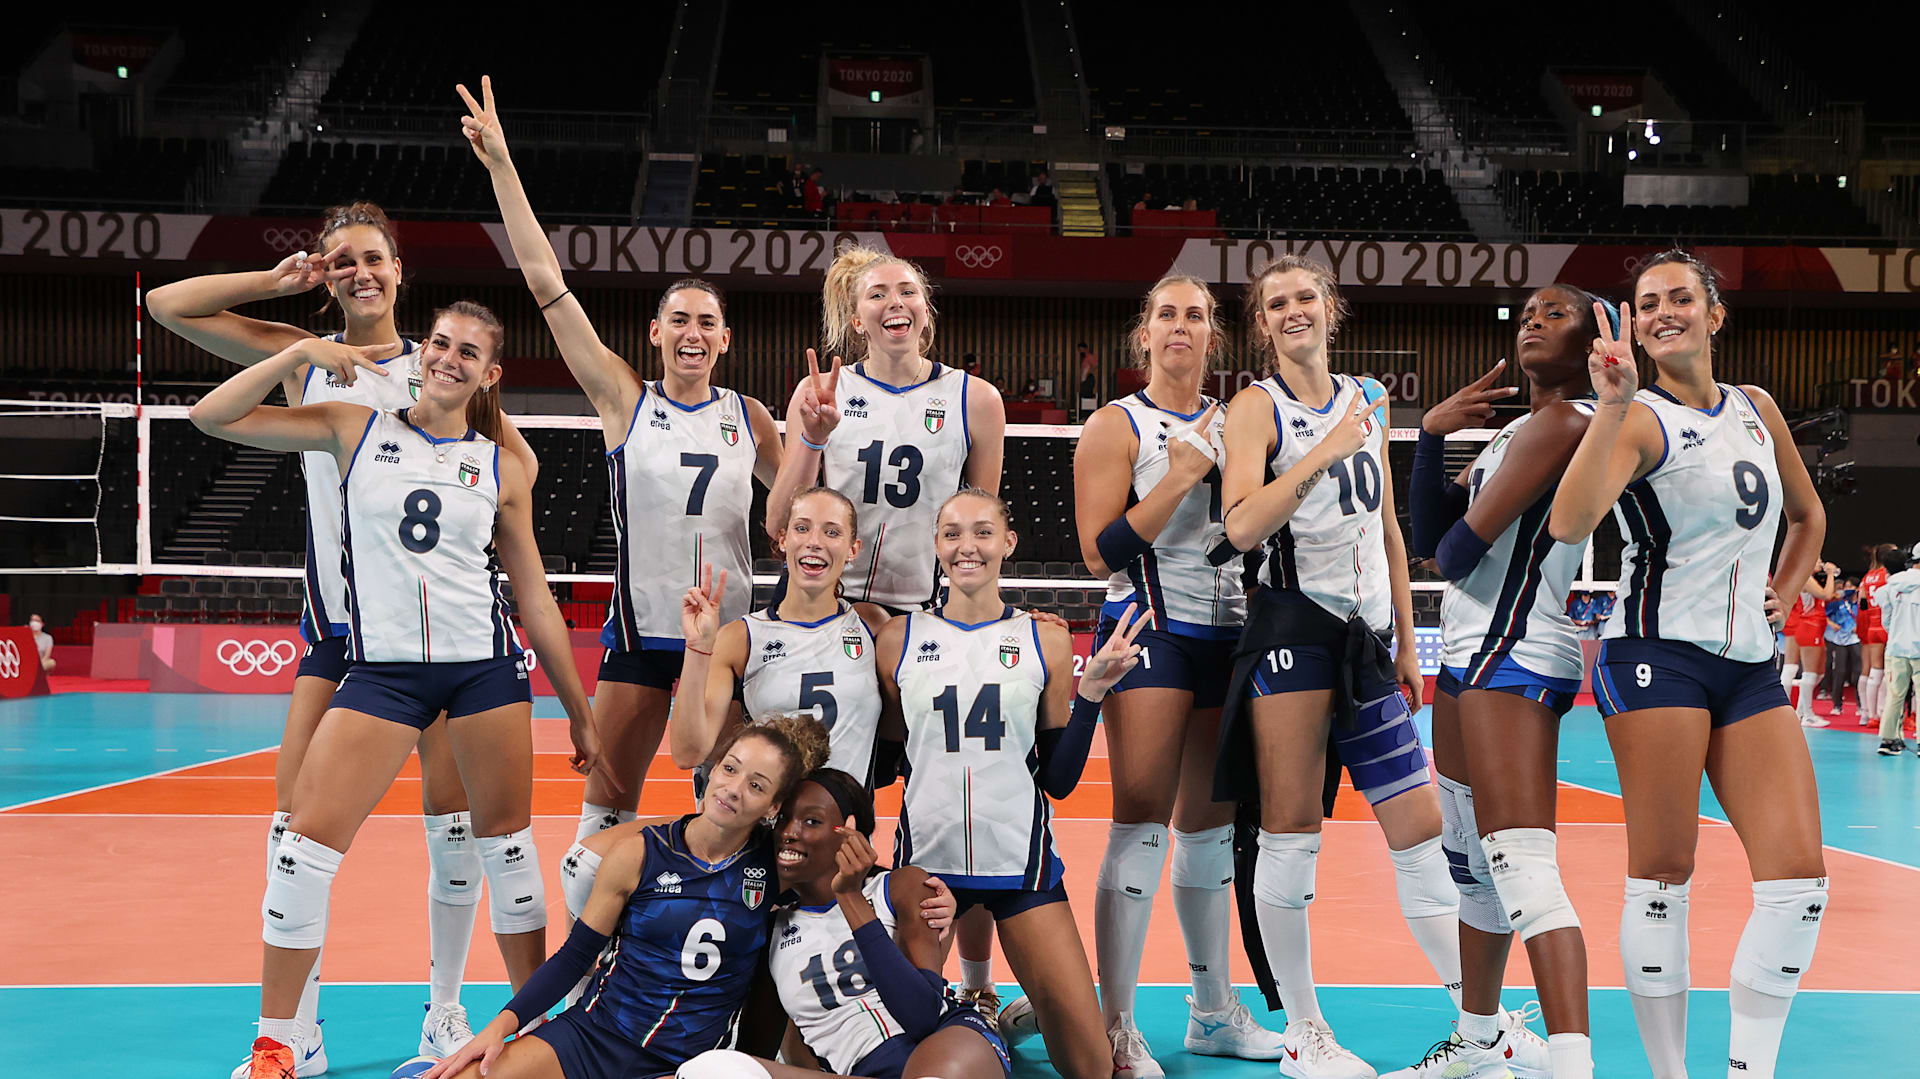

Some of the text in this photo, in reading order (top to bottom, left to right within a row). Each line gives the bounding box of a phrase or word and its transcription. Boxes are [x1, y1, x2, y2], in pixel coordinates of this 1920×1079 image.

[841, 69, 913, 82] TOKYO 2020
[1566, 84, 1633, 97] OKYO 2020
[22, 209, 161, 260] 2020
[1401, 242, 1529, 289] 2020
[1850, 379, 1918, 408] TOK
[844, 410, 868, 419] errea
[1390, 430, 1415, 438] OKYO
[374, 454, 400, 464] errea
[680, 453, 718, 515] 7
[857, 440, 923, 508] 13
[1328, 452, 1380, 516] 10
[1734, 461, 1769, 529] 9
[398, 489, 443, 554] 8
[917, 654, 940, 663] errea
[1266, 648, 1294, 673] 10
[1635, 663, 1652, 688] 9
[798, 671, 838, 742] 5
[933, 683, 1006, 753] 14
[654, 885, 682, 894] errea
[744, 880, 763, 888] ITALIA
[1645, 911, 1667, 919] errea
[681, 918, 726, 981] 6
[780, 936, 802, 950] errea
[799, 941, 873, 1010] 18
